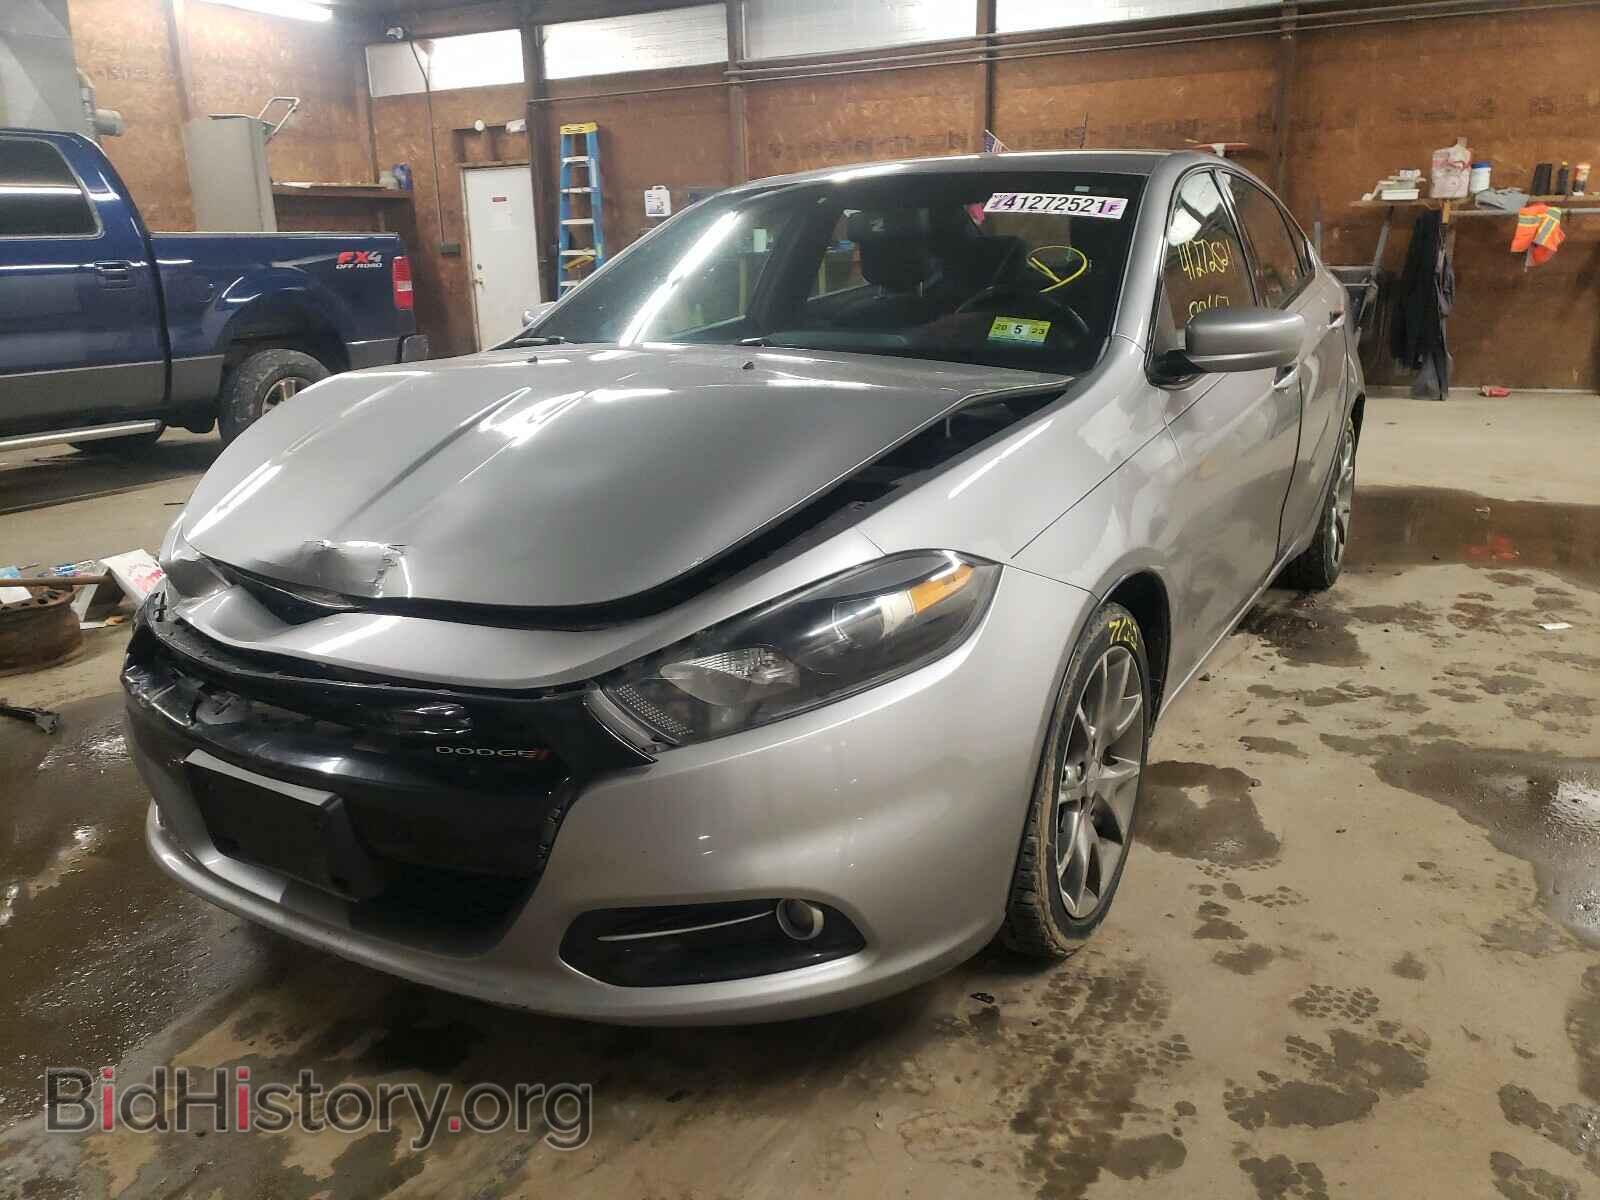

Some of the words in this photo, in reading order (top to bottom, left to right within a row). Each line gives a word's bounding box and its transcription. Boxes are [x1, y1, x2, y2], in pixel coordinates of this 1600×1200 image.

[337, 251, 383, 264] FX4
[1014, 324, 1024, 335] 5
[436, 746, 537, 758] DODGE
